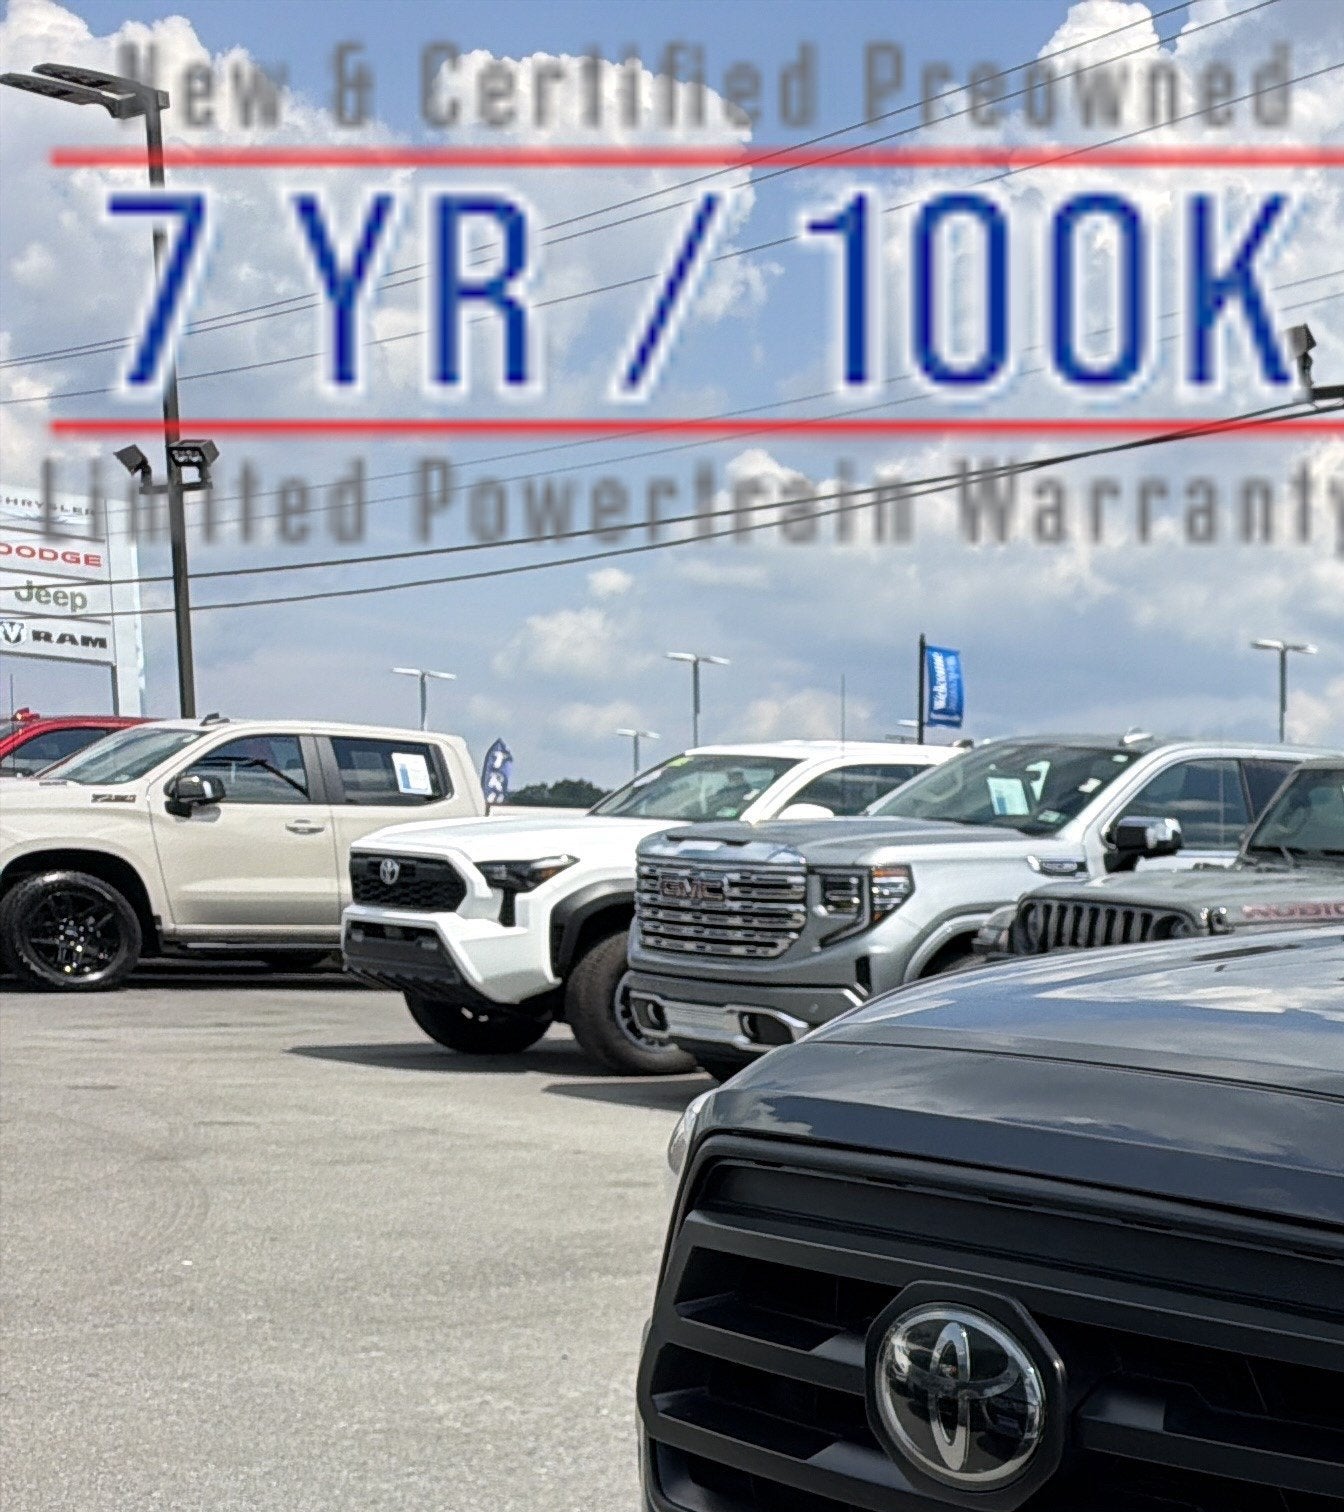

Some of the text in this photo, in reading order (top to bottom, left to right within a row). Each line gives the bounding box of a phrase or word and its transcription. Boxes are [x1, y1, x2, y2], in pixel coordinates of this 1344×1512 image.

[0, 496, 97, 517] HRYSLER
[0, 542, 102, 568] DODGE
[14, 579, 88, 612] Jeep
[32, 629, 108, 649] RAM
